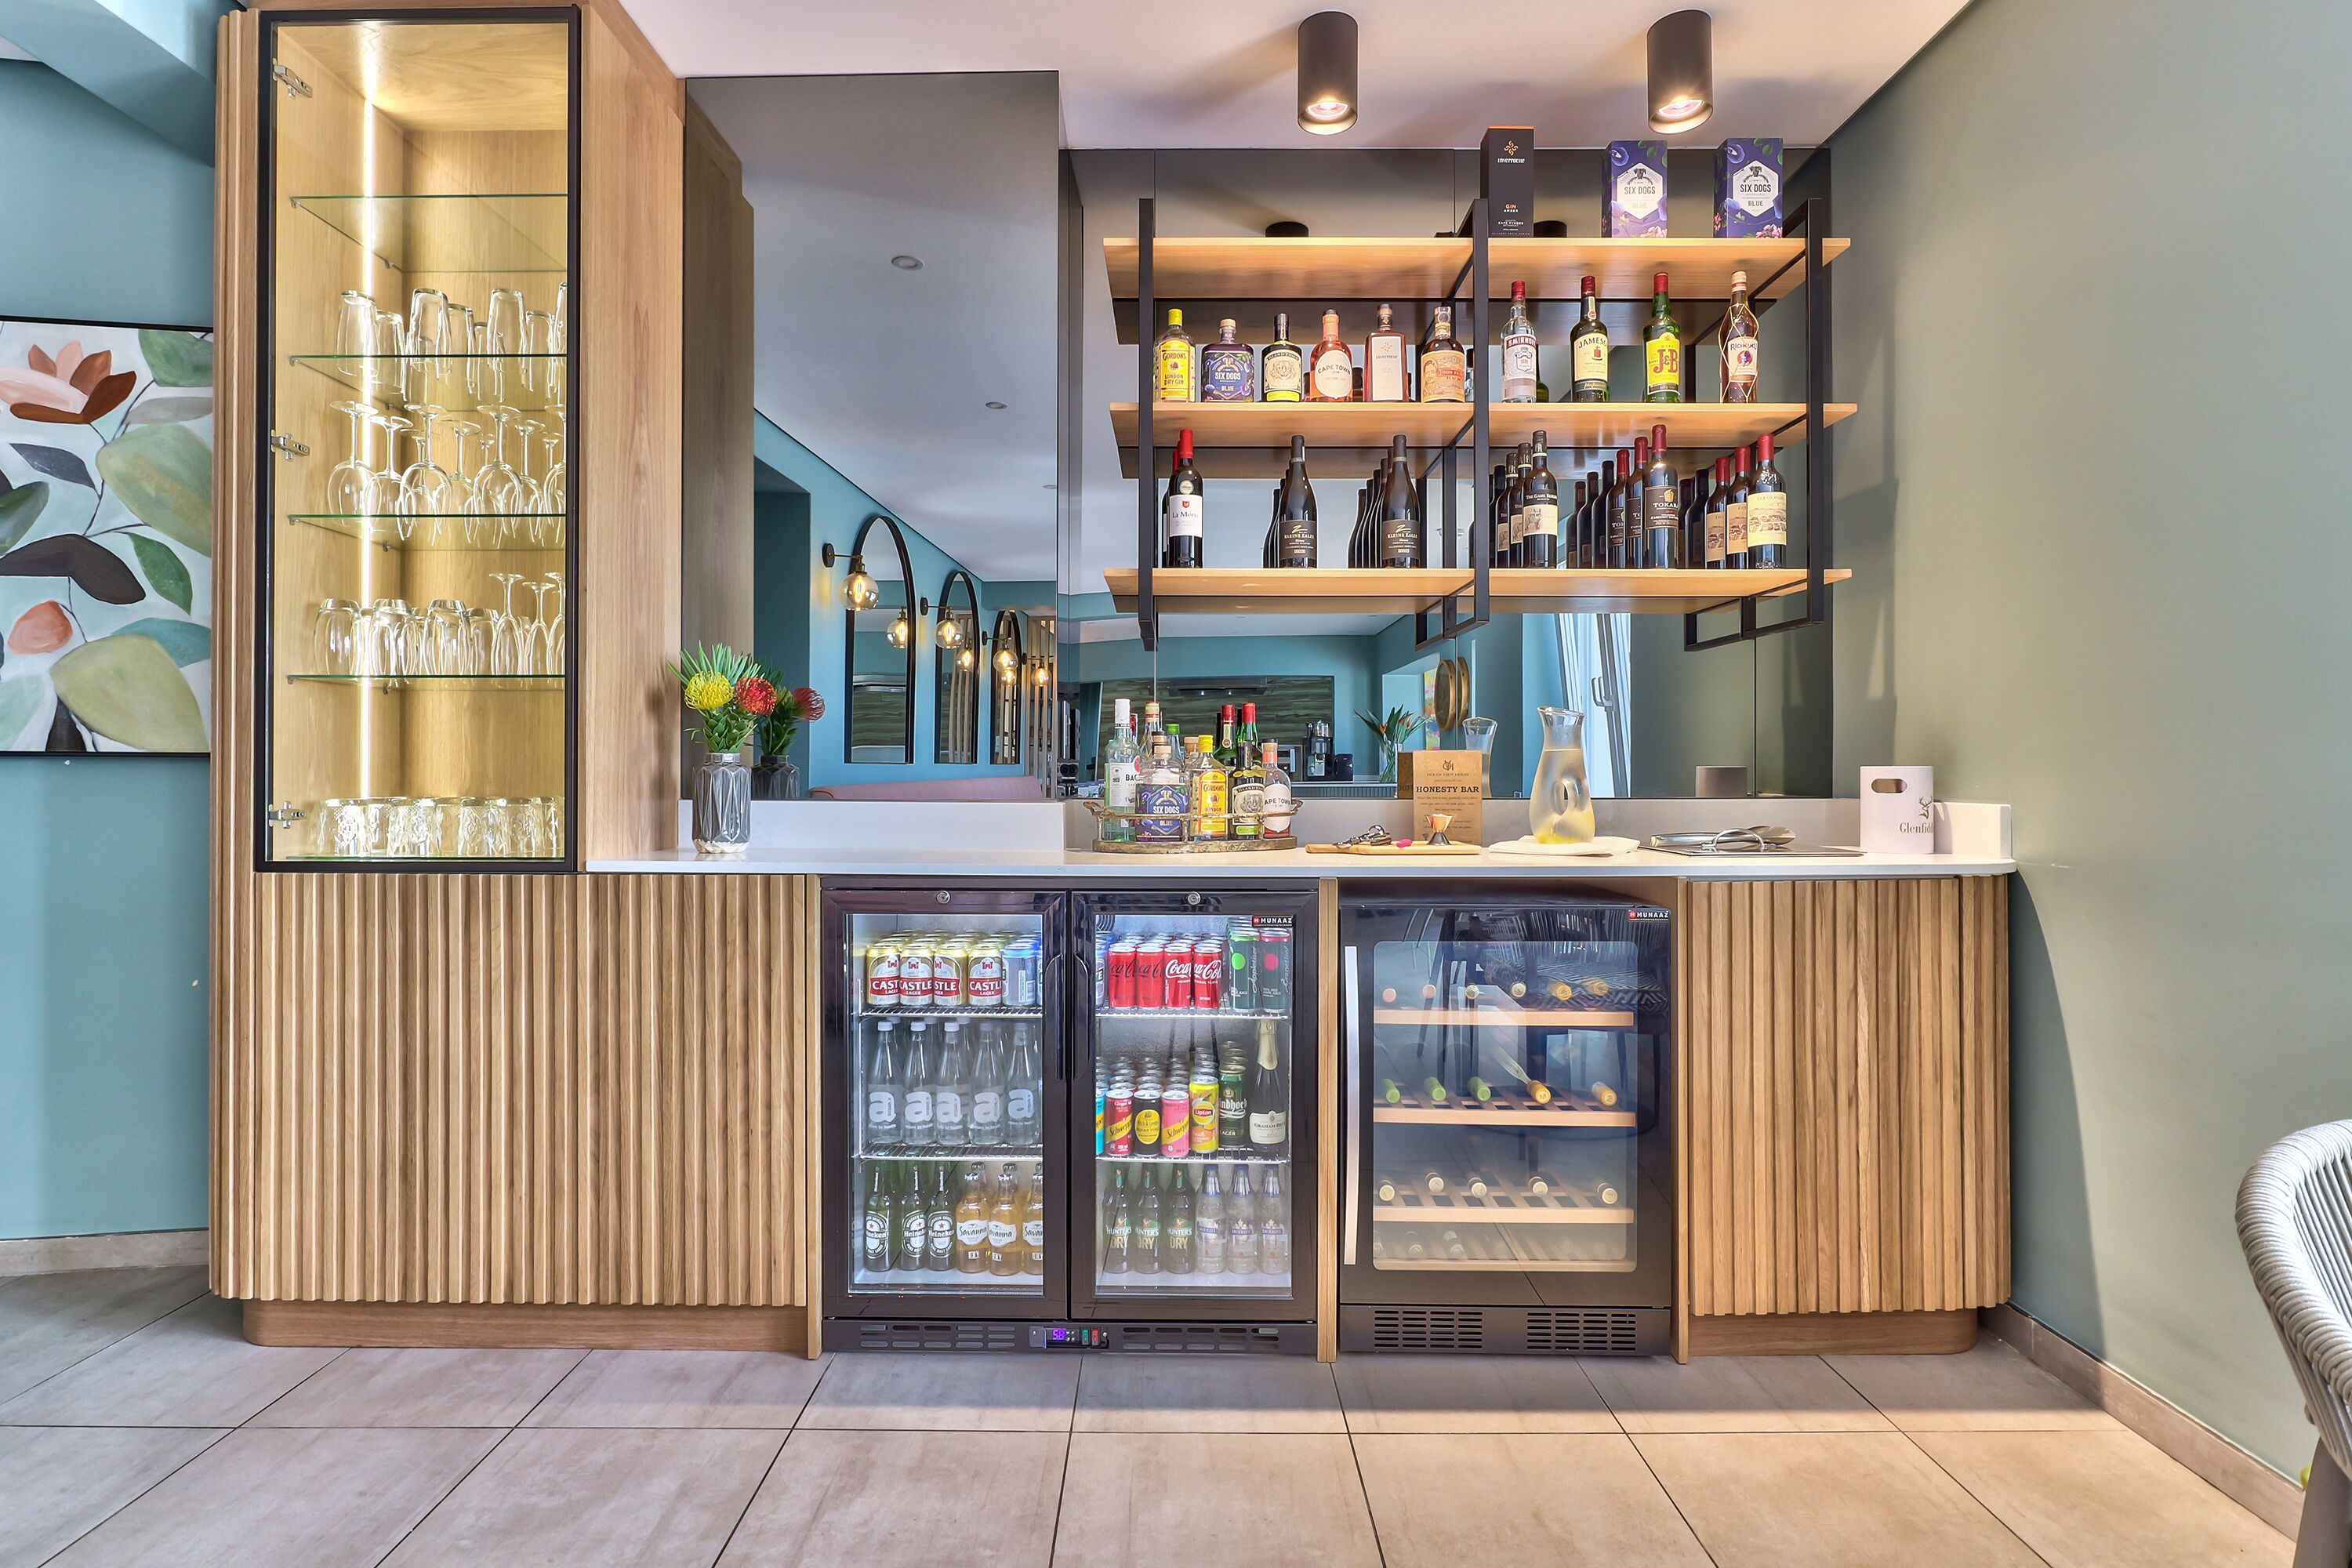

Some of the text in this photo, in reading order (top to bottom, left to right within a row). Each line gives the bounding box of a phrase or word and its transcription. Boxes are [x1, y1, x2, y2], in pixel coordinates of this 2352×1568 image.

[1624, 185, 1656, 194] SIX DOGS
[1740, 183, 1772, 193] SIX DOGS
[1578, 336, 1607, 349] JAMESO
[1653, 348, 1679, 374] J&B
[1215, 372, 1241, 380] SIX DOGS
[1318, 364, 1351, 376] CAPE TOWN
[1900, 822, 1933, 833] Glenfid
[872, 979, 899, 991] CAST
[934, 980, 956, 991] STLE
[1109, 1119, 1132, 1137] Schwepp
[1167, 1121, 1189, 1138] Schwepp
[903, 1229, 925, 1238] Heine
[959, 1225, 987, 1237] Savanna
[1024, 1225, 1043, 1237] Savan
[1110, 1236, 1129, 1249] DRY
[1170, 1236, 1189, 1250] DRY
